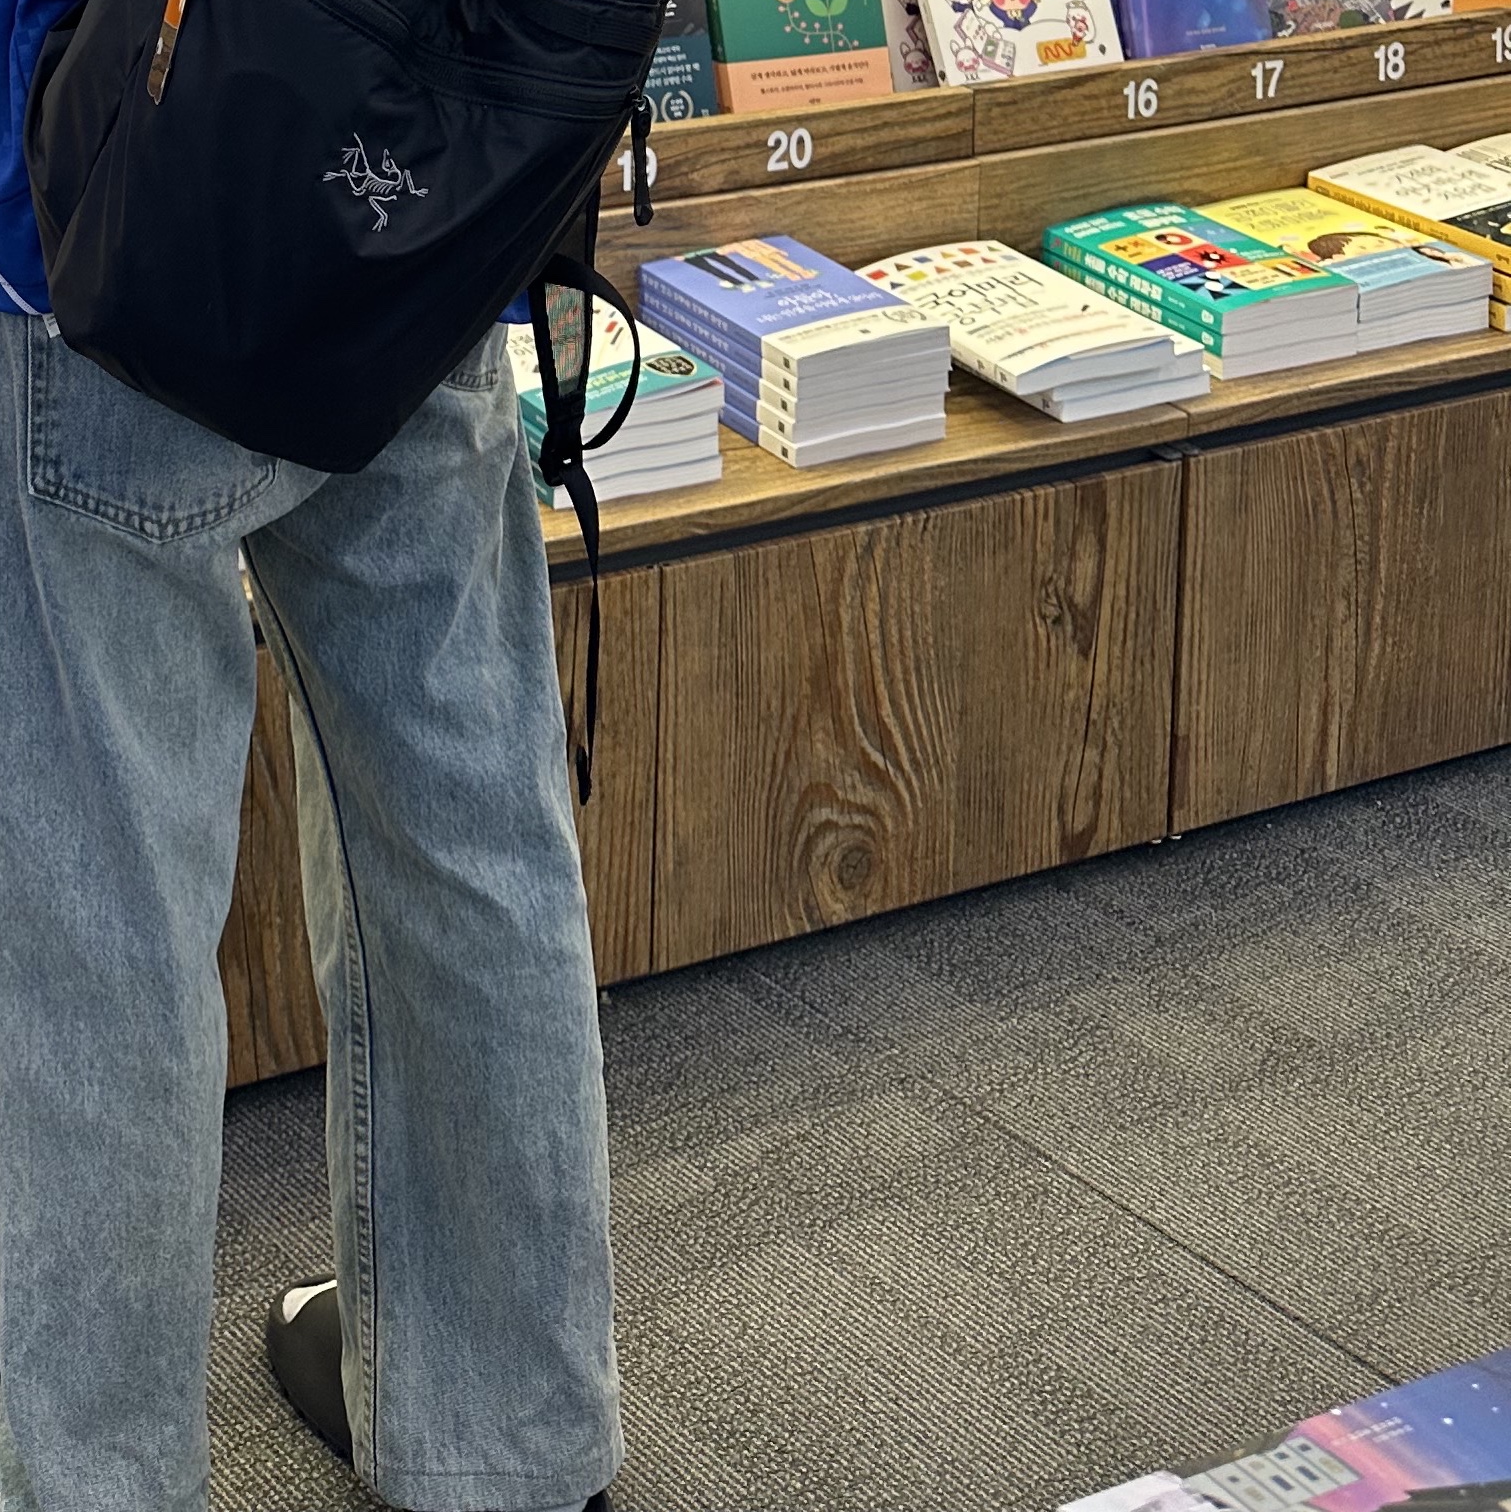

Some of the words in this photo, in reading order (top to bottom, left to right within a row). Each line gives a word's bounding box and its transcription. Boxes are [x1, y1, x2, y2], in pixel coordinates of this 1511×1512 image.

[1251, 60, 1285, 100] 17
[1373, 41, 1406, 82] 18
[1123, 79, 1159, 120] 16
[767, 127, 813, 171] 20
